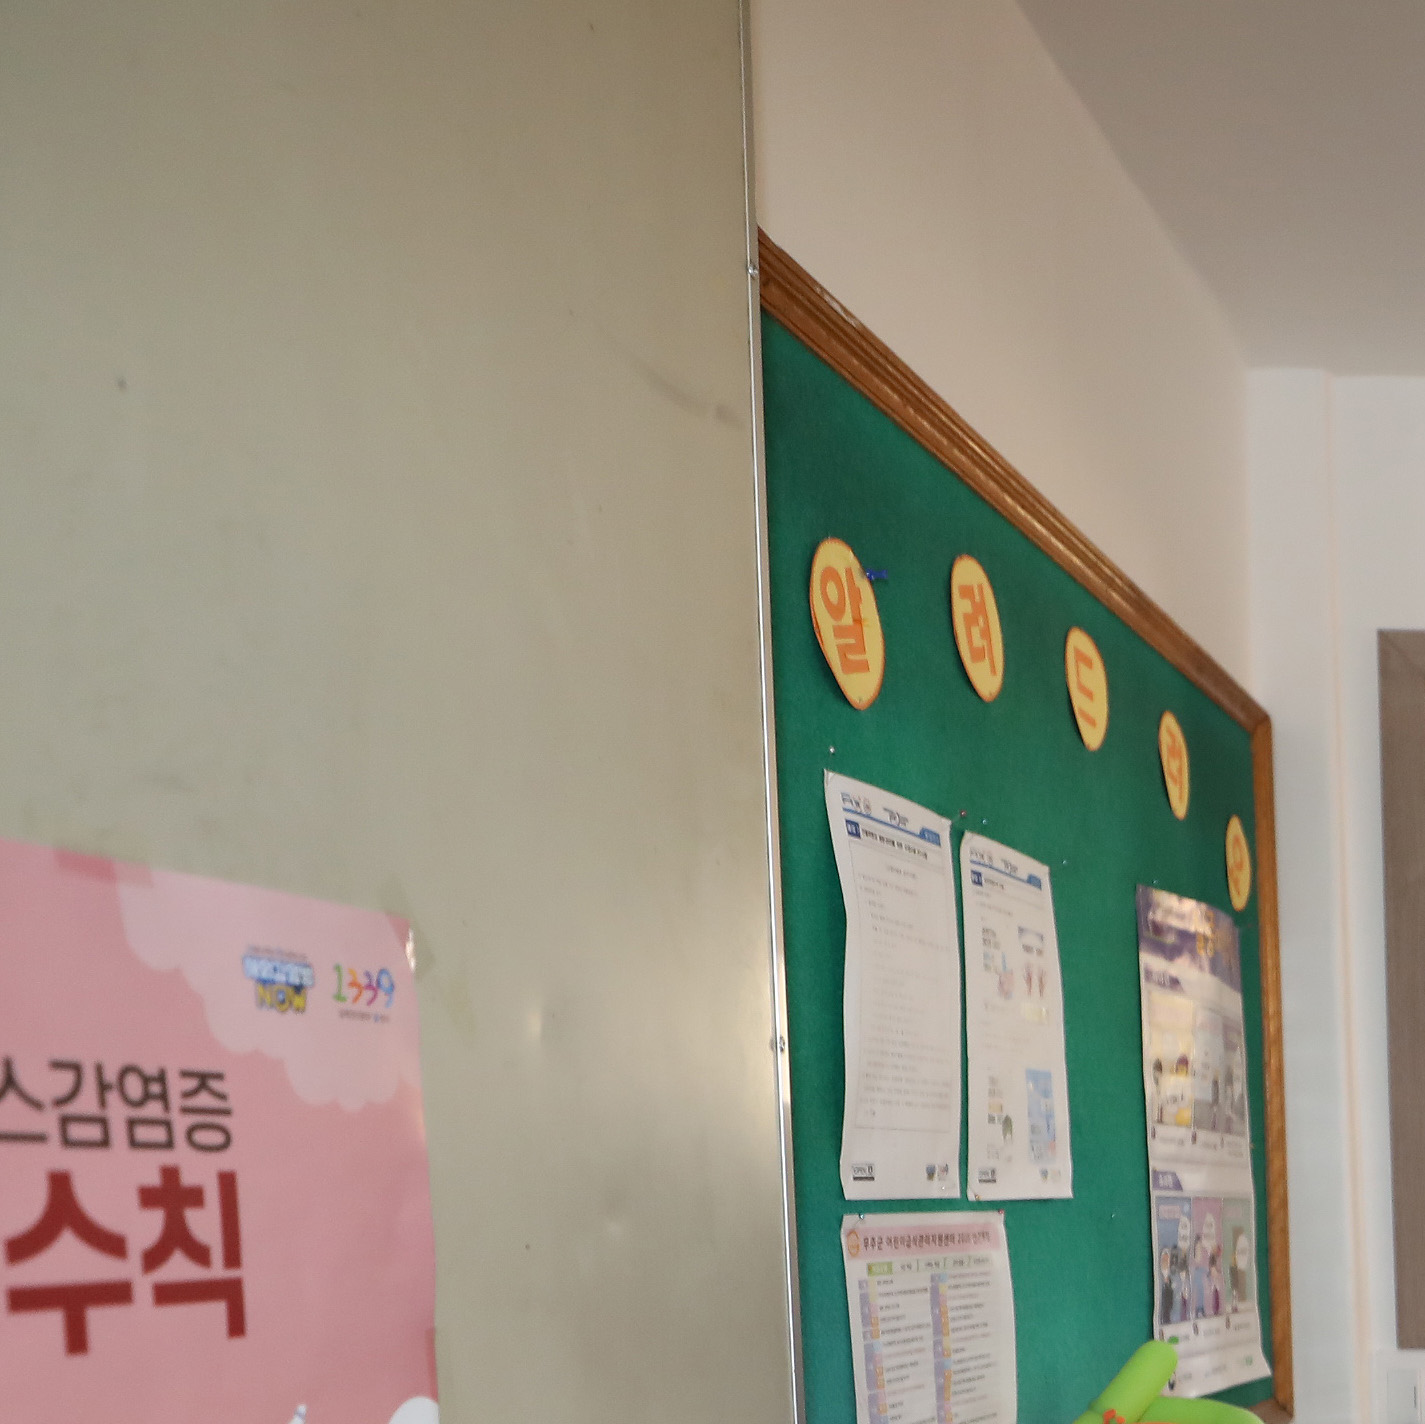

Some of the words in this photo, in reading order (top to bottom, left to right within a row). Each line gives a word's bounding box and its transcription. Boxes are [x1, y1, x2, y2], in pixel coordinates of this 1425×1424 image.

[818, 564, 871, 676] 알
[332, 963, 396, 1009] 1339
[4, 1164, 247, 1357] 수칙
